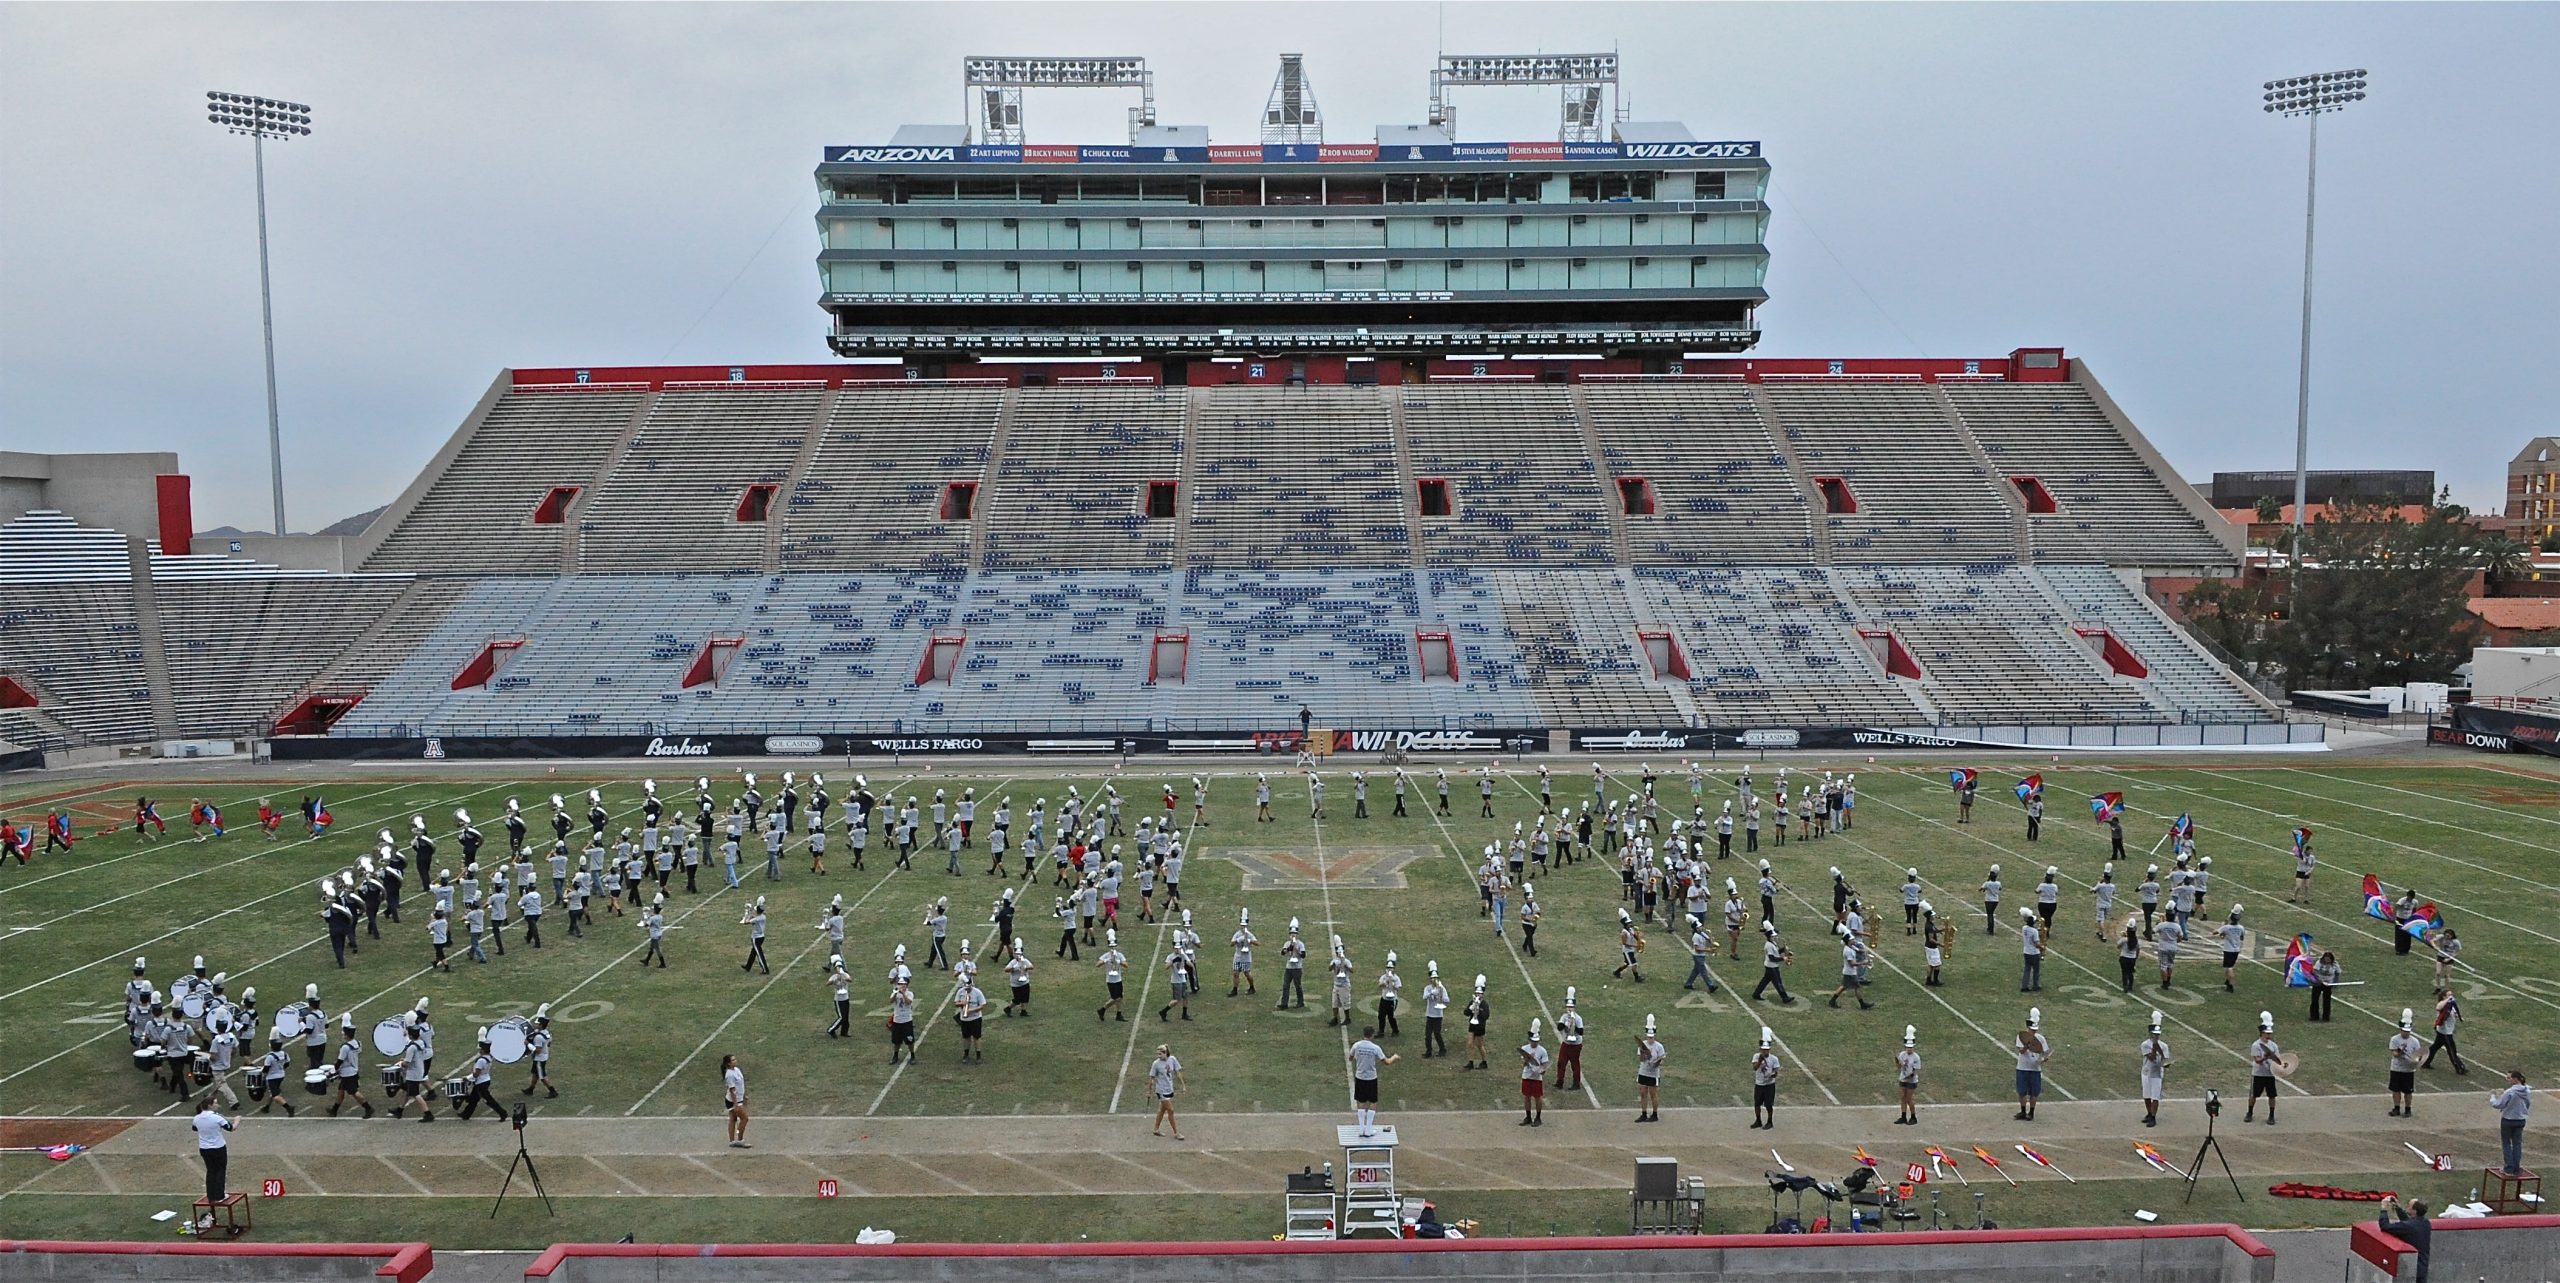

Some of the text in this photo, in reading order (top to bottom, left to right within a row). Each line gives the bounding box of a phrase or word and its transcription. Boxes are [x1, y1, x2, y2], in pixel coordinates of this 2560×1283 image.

[838, 148, 955, 161] ARIZONA
[970, 148, 1020, 157] 22 ART LUPPINO
[1032, 149, 1052, 157] RICKY
[1053, 149, 1078, 157] HUNLEY
[1328, 149, 1341, 157] ROB
[1342, 149, 1373, 157] WALDROP
[1461, 147, 1475, 155] STEVE
[1597, 146, 1618, 154] CASON
[1626, 144, 1752, 157] WILDCATS
[1102, 369, 1116, 378] 20
[1251, 367, 1263, 377] 21
[1474, 367, 1486, 375] 22
[1670, 366, 1683, 374] 23
[1830, 365, 1842, 374] 24
[1966, 366, 1978, 374] 25
[577, 375, 588, 383] 17
[731, 372, 743, 381] 18
[906, 370, 917, 379] 19
[230, 542, 241, 551] 16
[1853, 733, 1904, 744] WELLS
[2433, 729, 2507, 749] BEAR DOWN
[645, 737, 712, 755] Bashas'
[786, 740, 817, 748] CASINOS
[878, 739, 983, 750] WELLS FARGO
[2058, 984, 2206, 1008] 30
[1675, 990, 1812, 1013] 40
[465, 1001, 615, 1023] 30
[2437, 1155, 2451, 1170] 30
[1360, 1168, 1376, 1182] 50
[1908, 1166, 1922, 1182] 40
[265, 1181, 281, 1196] 30
[820, 1181, 836, 1196] 40
